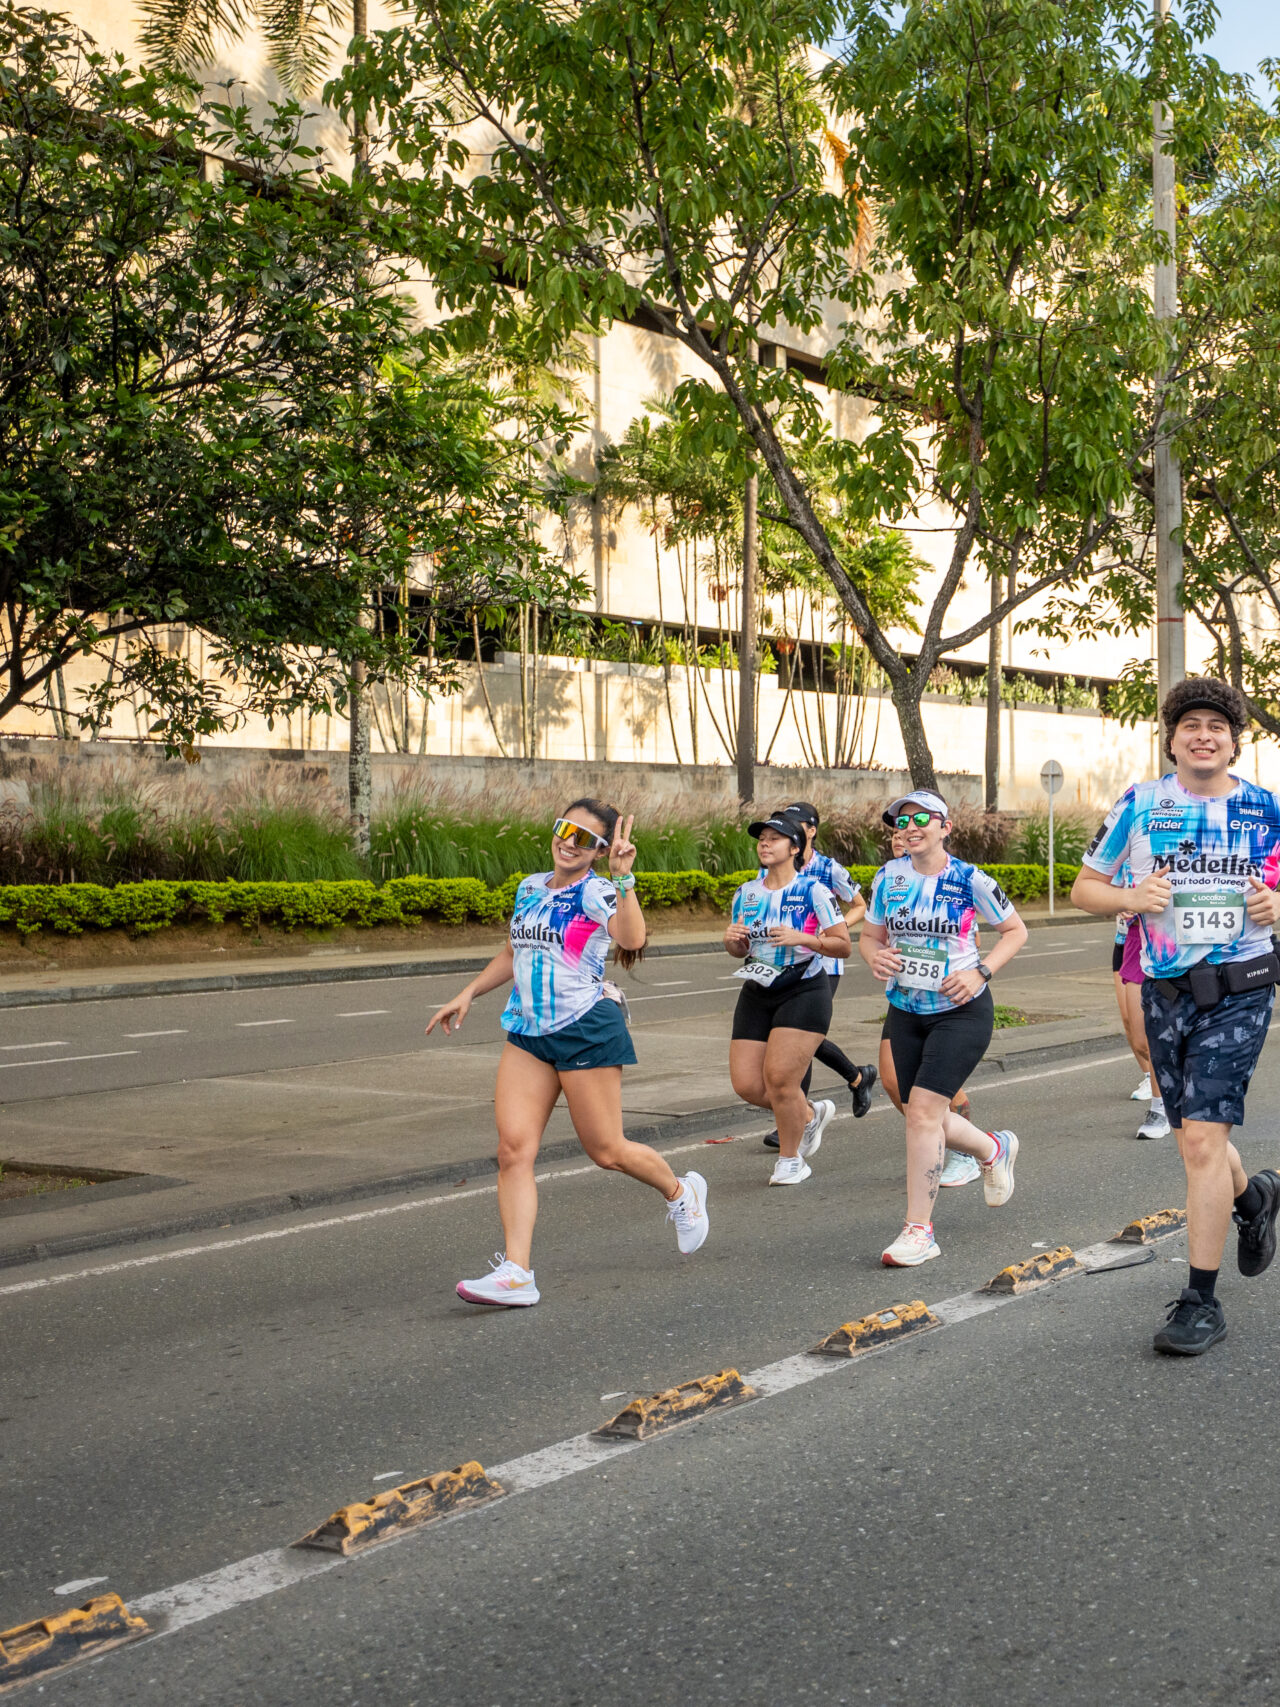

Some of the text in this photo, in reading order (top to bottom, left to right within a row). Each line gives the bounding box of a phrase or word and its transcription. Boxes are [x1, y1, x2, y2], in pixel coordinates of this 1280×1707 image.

[1230, 819, 1270, 837] epm
[1151, 854, 1261, 877] Medellín
[1213, 878, 1246, 887] florece
[782, 904, 805, 914] epm
[1183, 911, 1236, 930] 5143
[511, 923, 563, 944] edellín
[899, 959, 940, 979] 5558
[1247, 967, 1270, 979] KIPRUN
